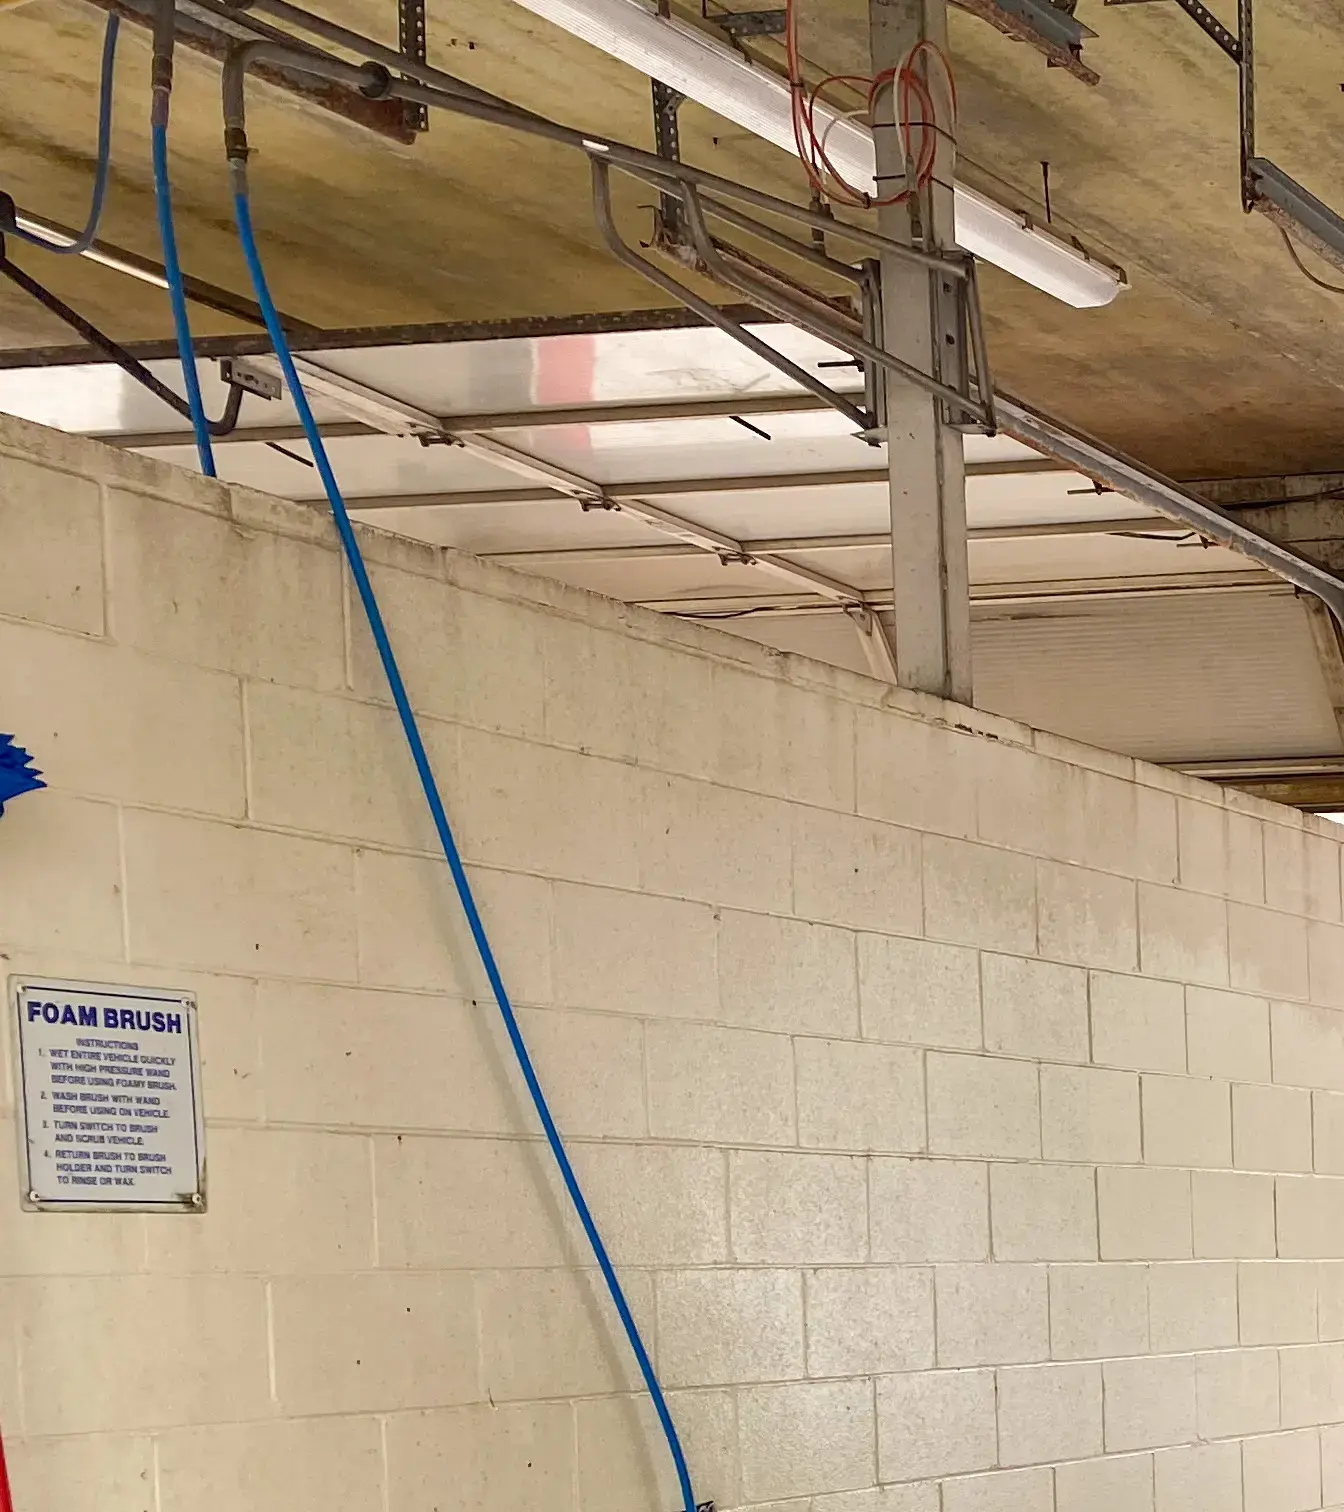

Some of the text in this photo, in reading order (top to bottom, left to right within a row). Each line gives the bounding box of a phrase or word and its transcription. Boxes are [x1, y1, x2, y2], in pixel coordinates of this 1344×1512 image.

[26, 1001, 182, 1034] FOAM BRUSH
[76, 1038, 138, 1050] INSTRUCTIONS
[49, 1049, 68, 1058] WET
[70, 1050, 102, 1060] ENTIRE
[103, 1052, 138, 1063] VEHICLE
[140, 1055, 176, 1065] QUICKLY
[50, 1062, 170, 1078] WITH HIGH PRESSURE WAND
[51, 1074, 86, 1084] BEFORE
[88, 1077, 114, 1086] USING
[116, 1079, 146, 1088] FOAMY
[52, 1092, 78, 1100] WASH
[80, 1092, 109, 1102] BRUSH
[111, 1094, 132, 1103] WITH
[135, 1096, 160, 1106] WAND
[53, 1104, 88, 1114] BEFORE
[90, 1106, 116, 1116] USING
[119, 1108, 132, 1116] ON
[54, 1120, 78, 1130] TURN
[80, 1122, 114, 1131] SWITCH
[115, 1124, 128, 1132] TO
[130, 1124, 158, 1133] BRUSH
[55, 1134, 73, 1142] AND
[76, 1134, 105, 1144] SCRUB
[56, 1150, 90, 1159] RETURN
[93, 1152, 122, 1160] BRUSH
[124, 1152, 136, 1160] TO
[138, 1152, 166, 1162] BRUSH
[56, 1163, 172, 1174] HOLDER AND TURN SWITCH
[57, 1176, 70, 1184] TO
[72, 1176, 98, 1185] RINSE
[100, 1178, 112, 1186] OR
